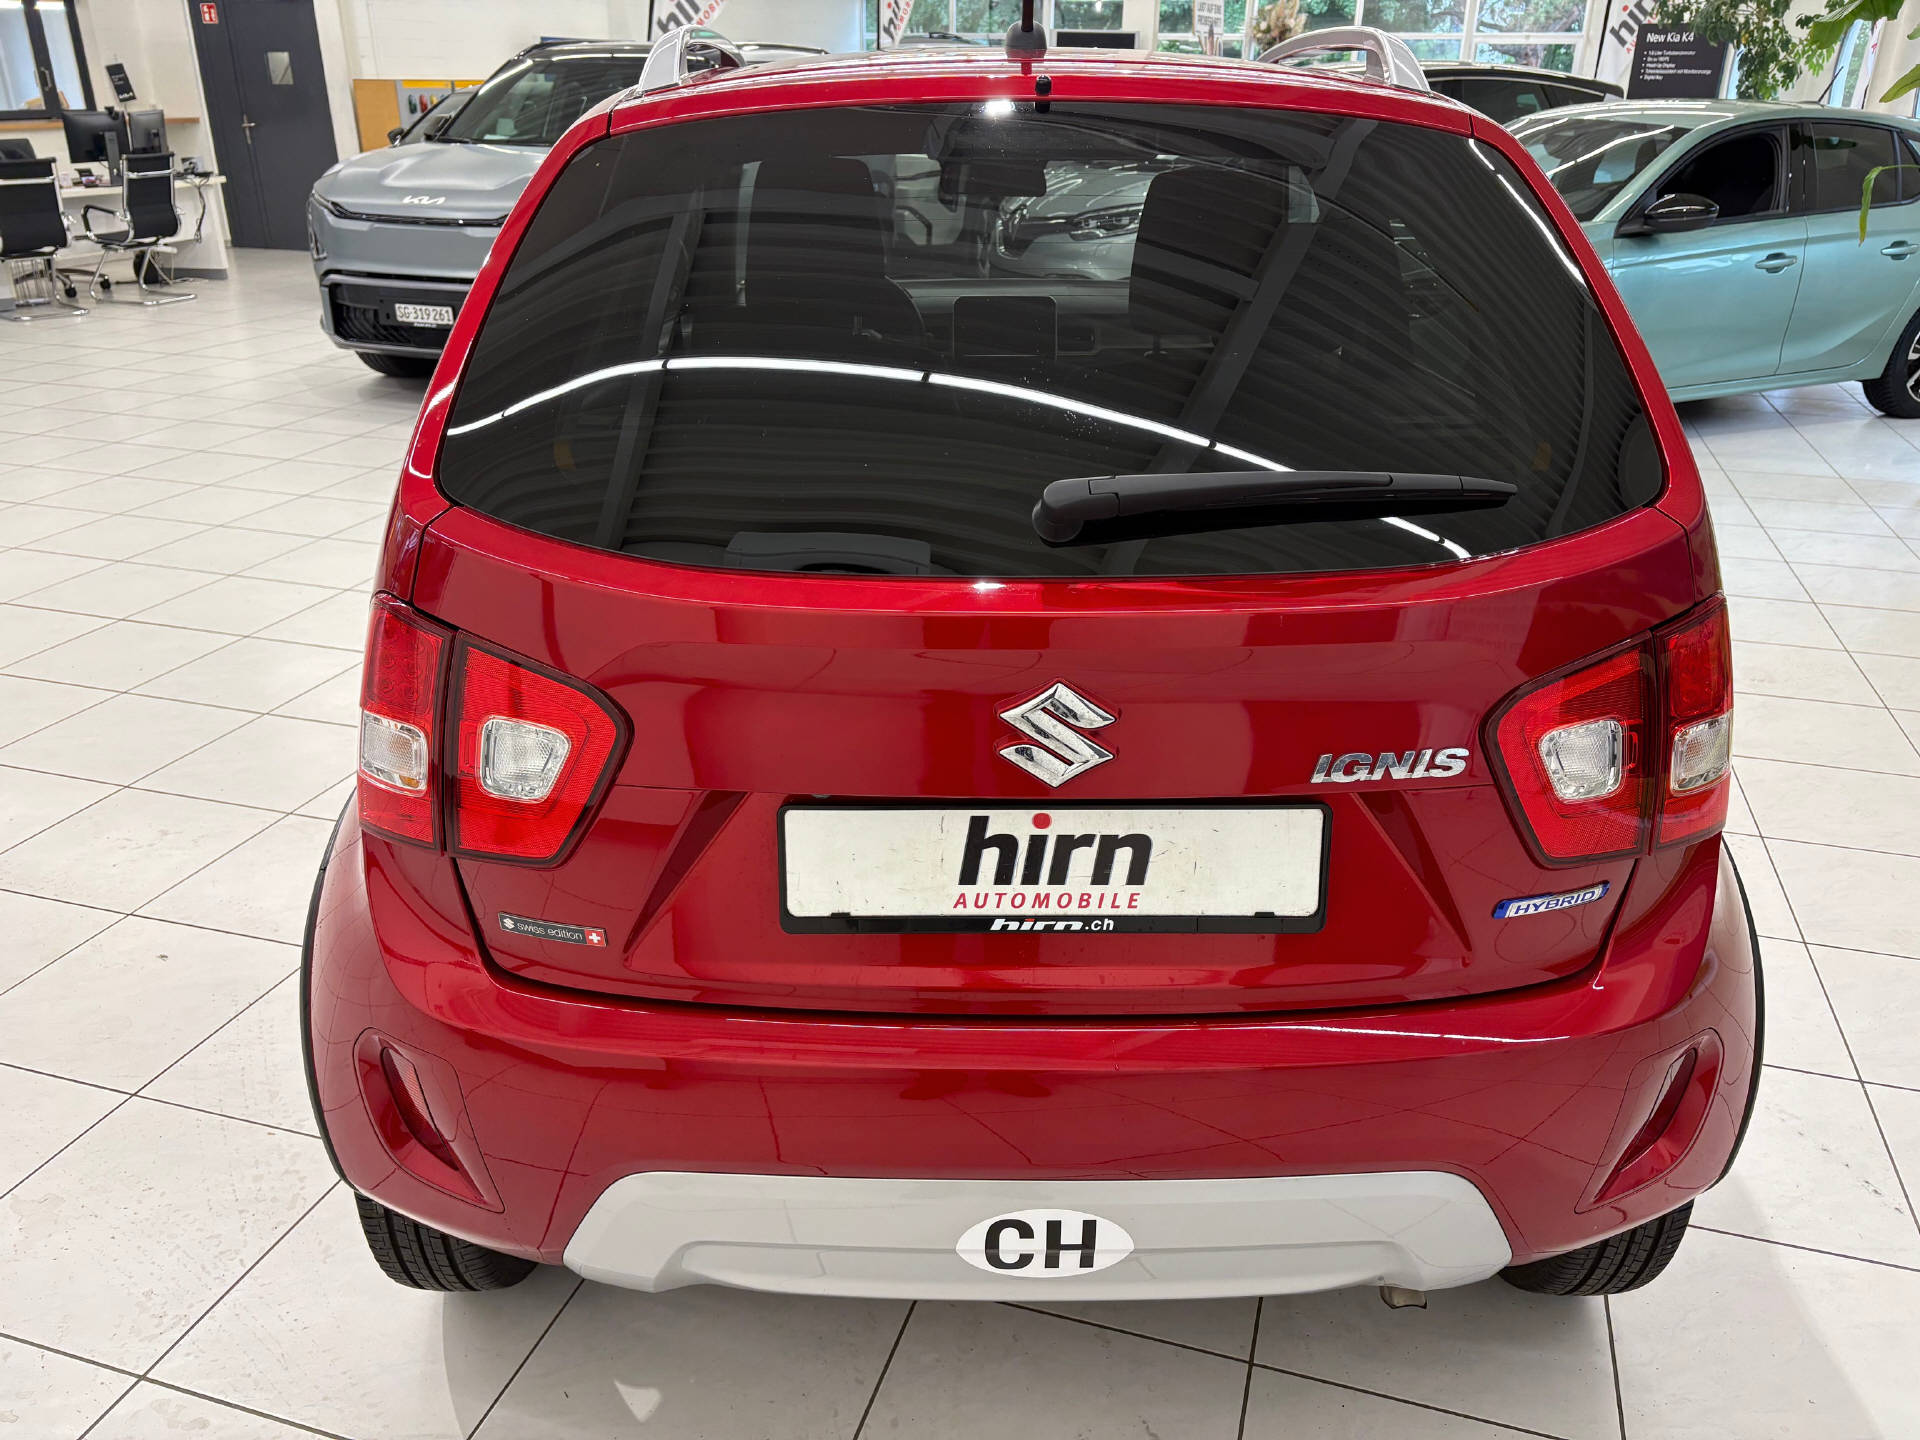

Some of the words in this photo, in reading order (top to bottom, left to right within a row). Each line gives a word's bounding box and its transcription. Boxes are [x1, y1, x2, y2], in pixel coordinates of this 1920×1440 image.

[1646, 32, 1665, 43] New
[1666, 32, 1680, 43] Kia
[1681, 31, 1695, 43] K4
[1310, 748, 1470, 784] IGNIS
[957, 812, 1153, 886] hirn
[953, 892, 1141, 910] AUTOMOBILE
[1514, 890, 1597, 915] HYBRID
[516, 922, 546, 935] swiss
[547, 927, 583, 941] edition
[989, 917, 1115, 932] hirn.ch
[984, 1218, 1098, 1270] CH
